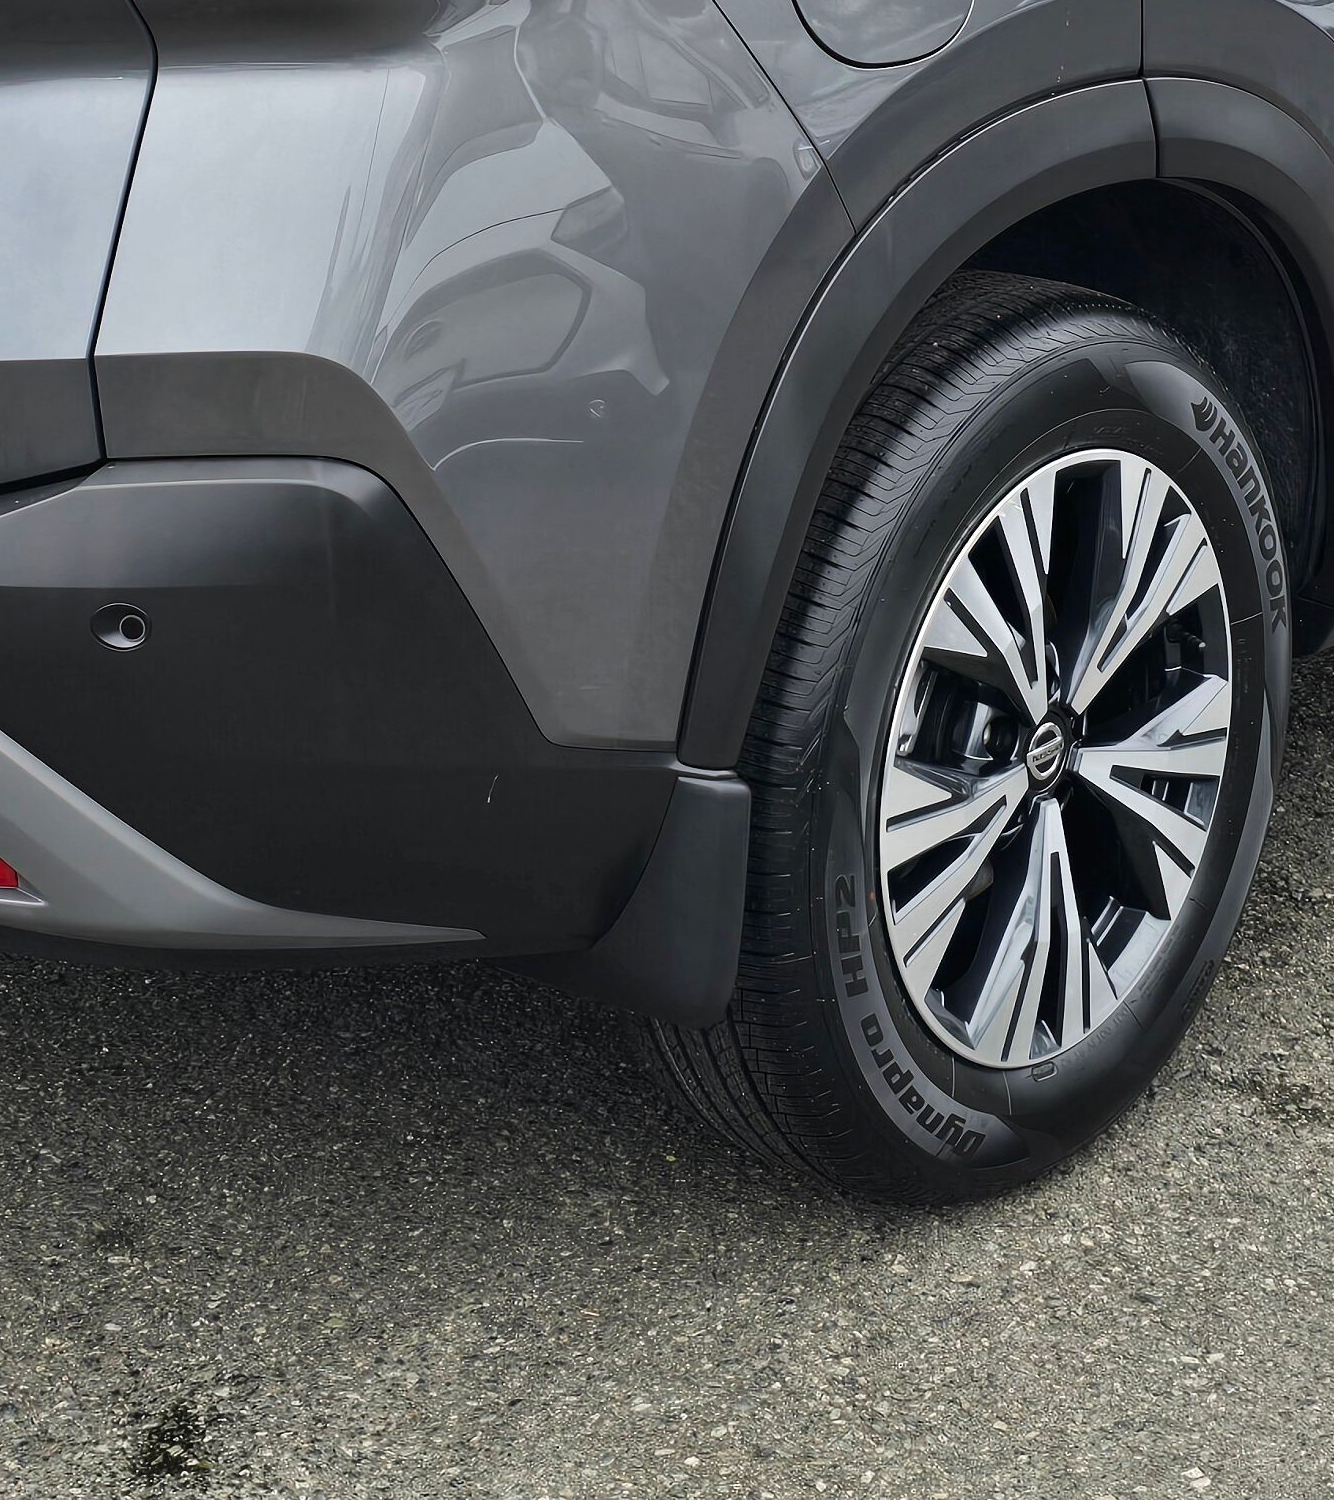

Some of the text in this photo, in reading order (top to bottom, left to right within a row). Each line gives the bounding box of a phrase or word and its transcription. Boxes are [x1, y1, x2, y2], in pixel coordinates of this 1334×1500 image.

[1209, 416, 1288, 635] Hankook
[834, 874, 988, 1161] Dynapro HP2
